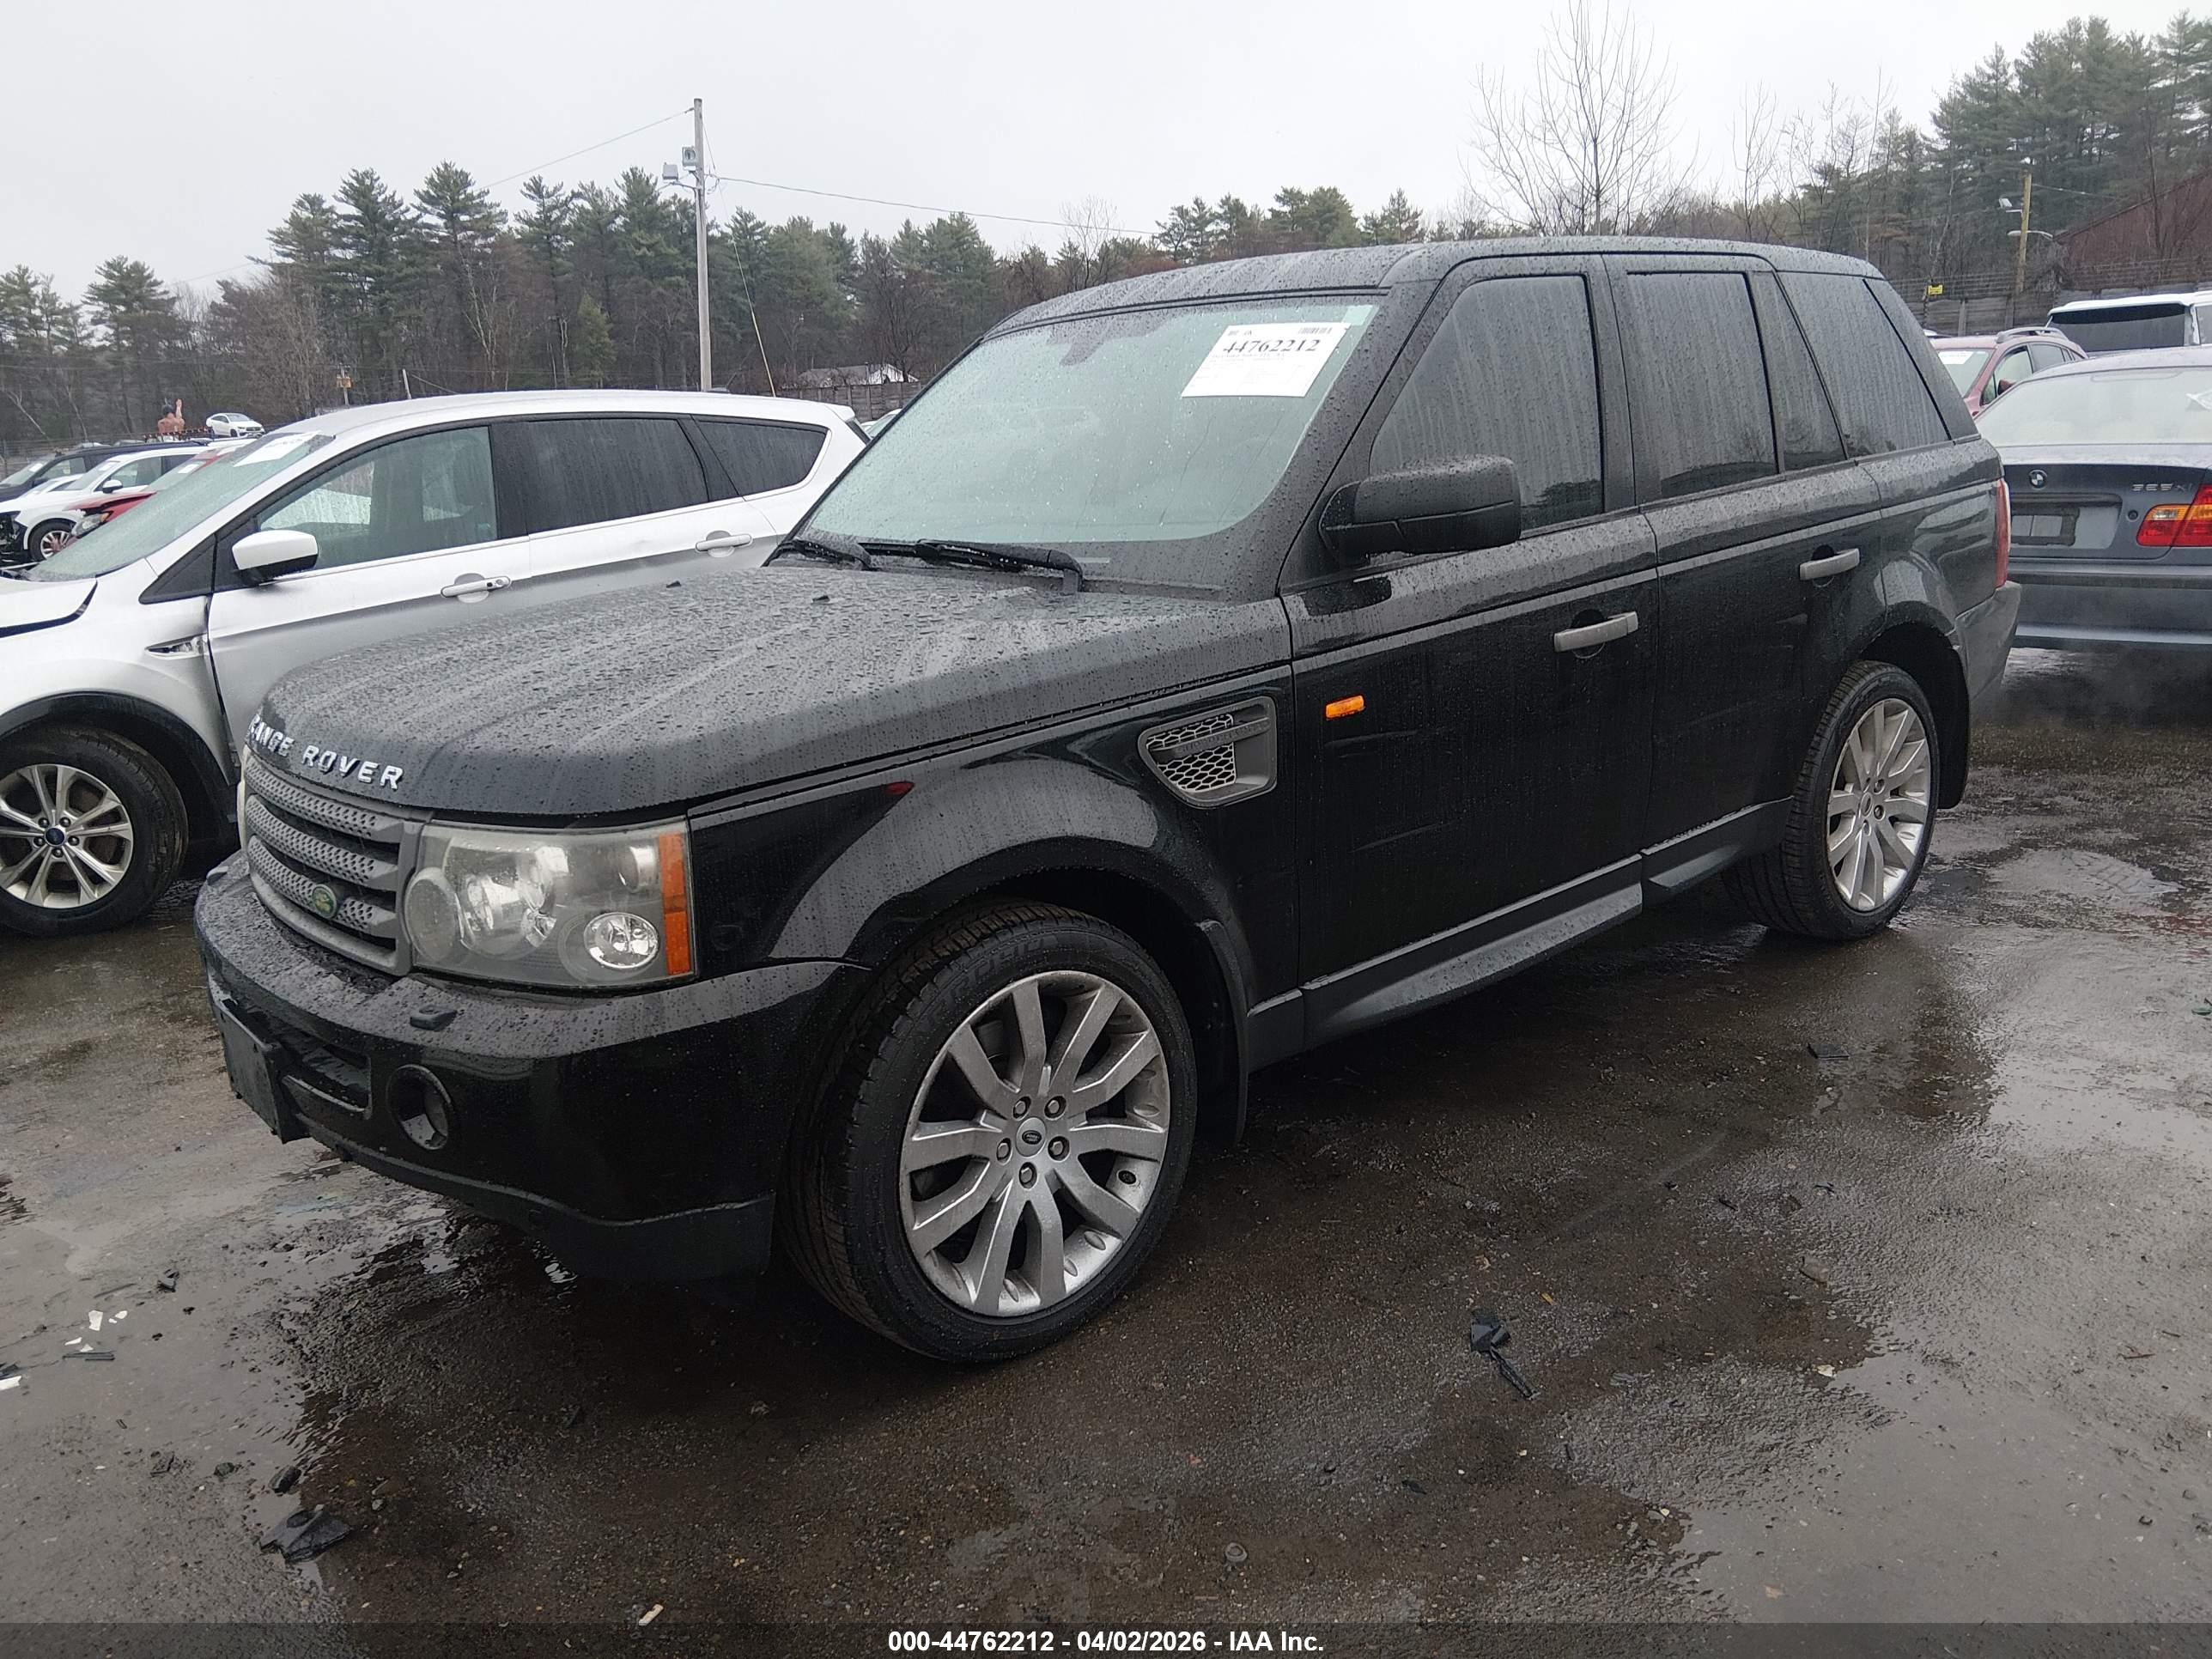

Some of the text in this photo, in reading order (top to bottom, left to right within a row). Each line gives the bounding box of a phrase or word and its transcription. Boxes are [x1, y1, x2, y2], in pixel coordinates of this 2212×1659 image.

[1223, 339, 1321, 353] 44762212
[247, 714, 404, 790] RANGE ROVER
